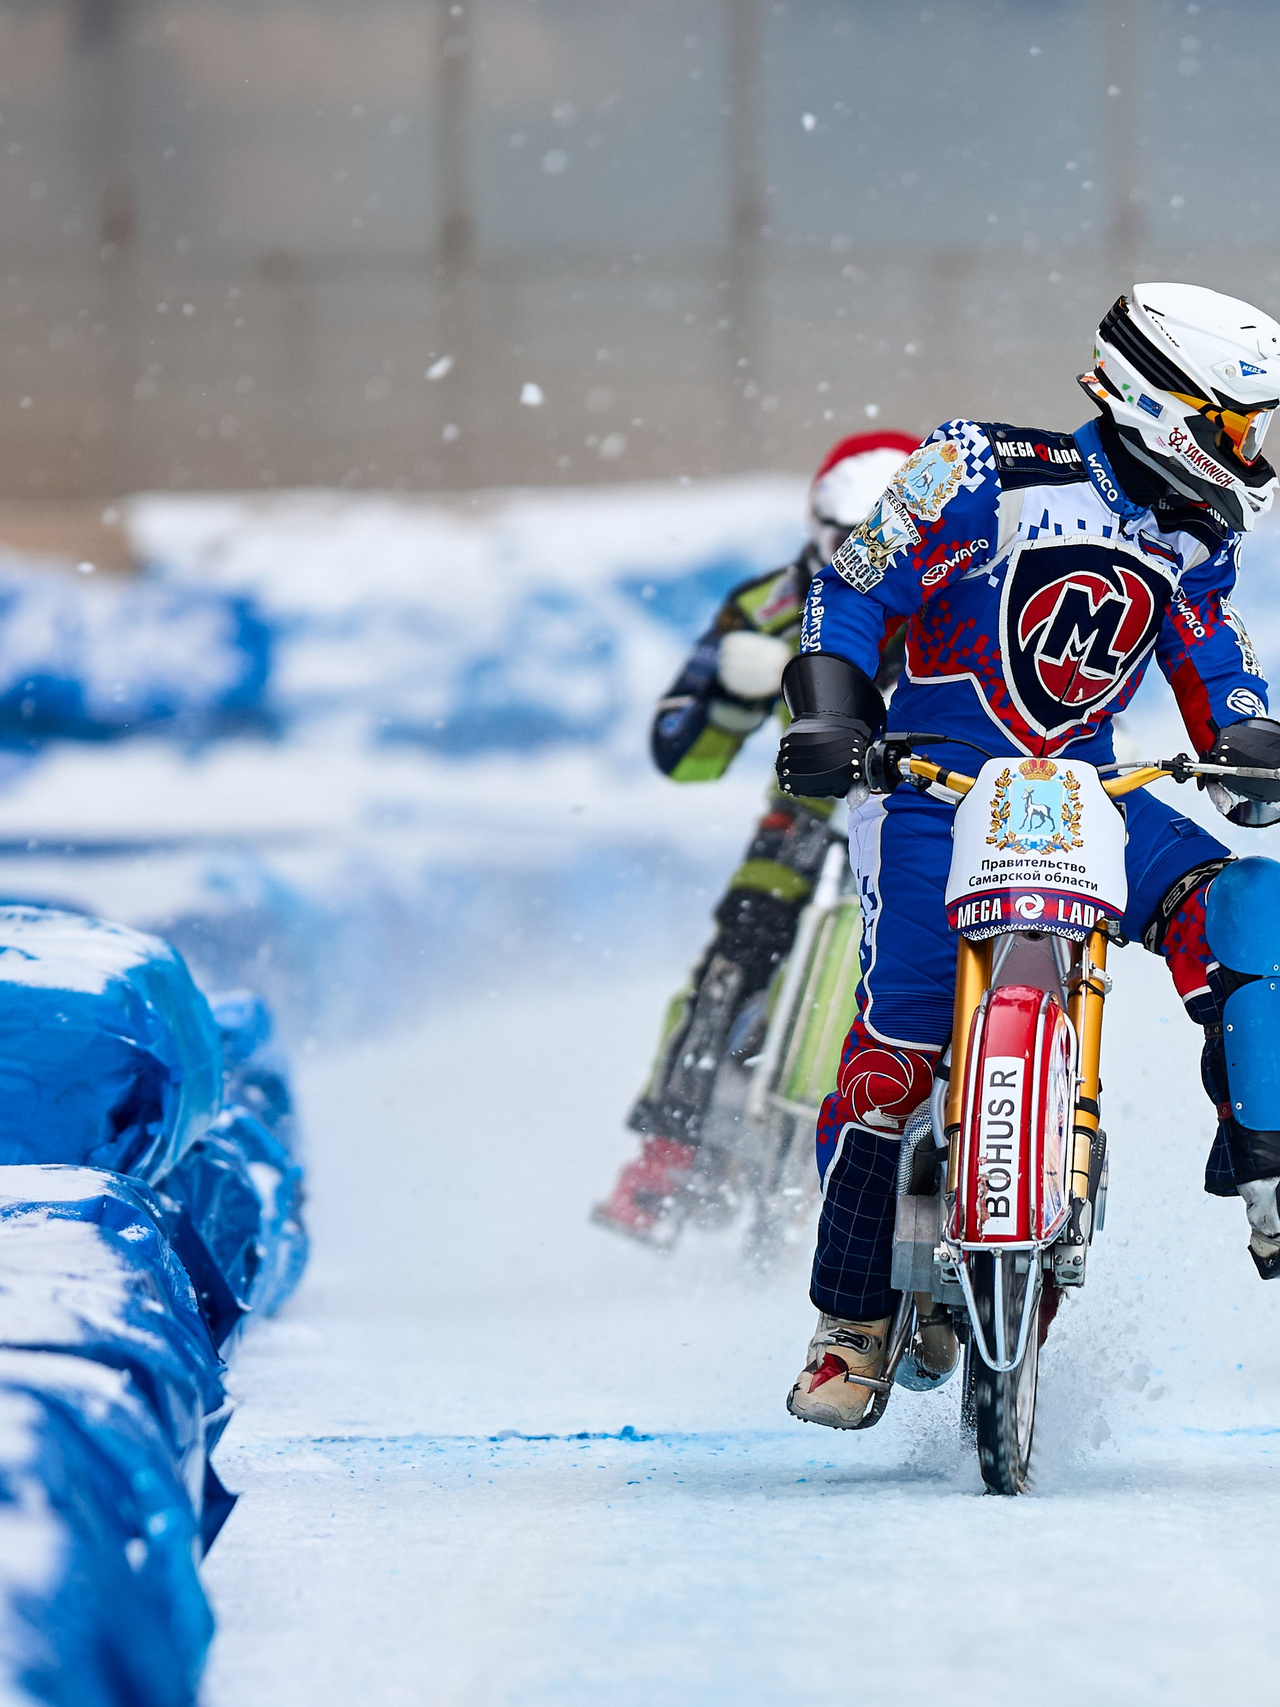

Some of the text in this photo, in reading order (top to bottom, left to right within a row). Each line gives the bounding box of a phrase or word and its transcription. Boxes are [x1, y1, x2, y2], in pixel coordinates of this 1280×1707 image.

[995, 441, 1082, 463] MEGA LADA
[1184, 443, 1235, 487] YAKHNICH
[1087, 453, 1118, 502] WACO
[899, 510, 921, 543] MAKER
[946, 539, 989, 568] WACO
[1177, 600, 1205, 638] WACO
[968, 871, 1098, 891] Самарской области
[981, 859, 1086, 874] Правительство
[956, 898, 1003, 929] MEGA
[986, 1070, 1017, 1218] BOHUS R
